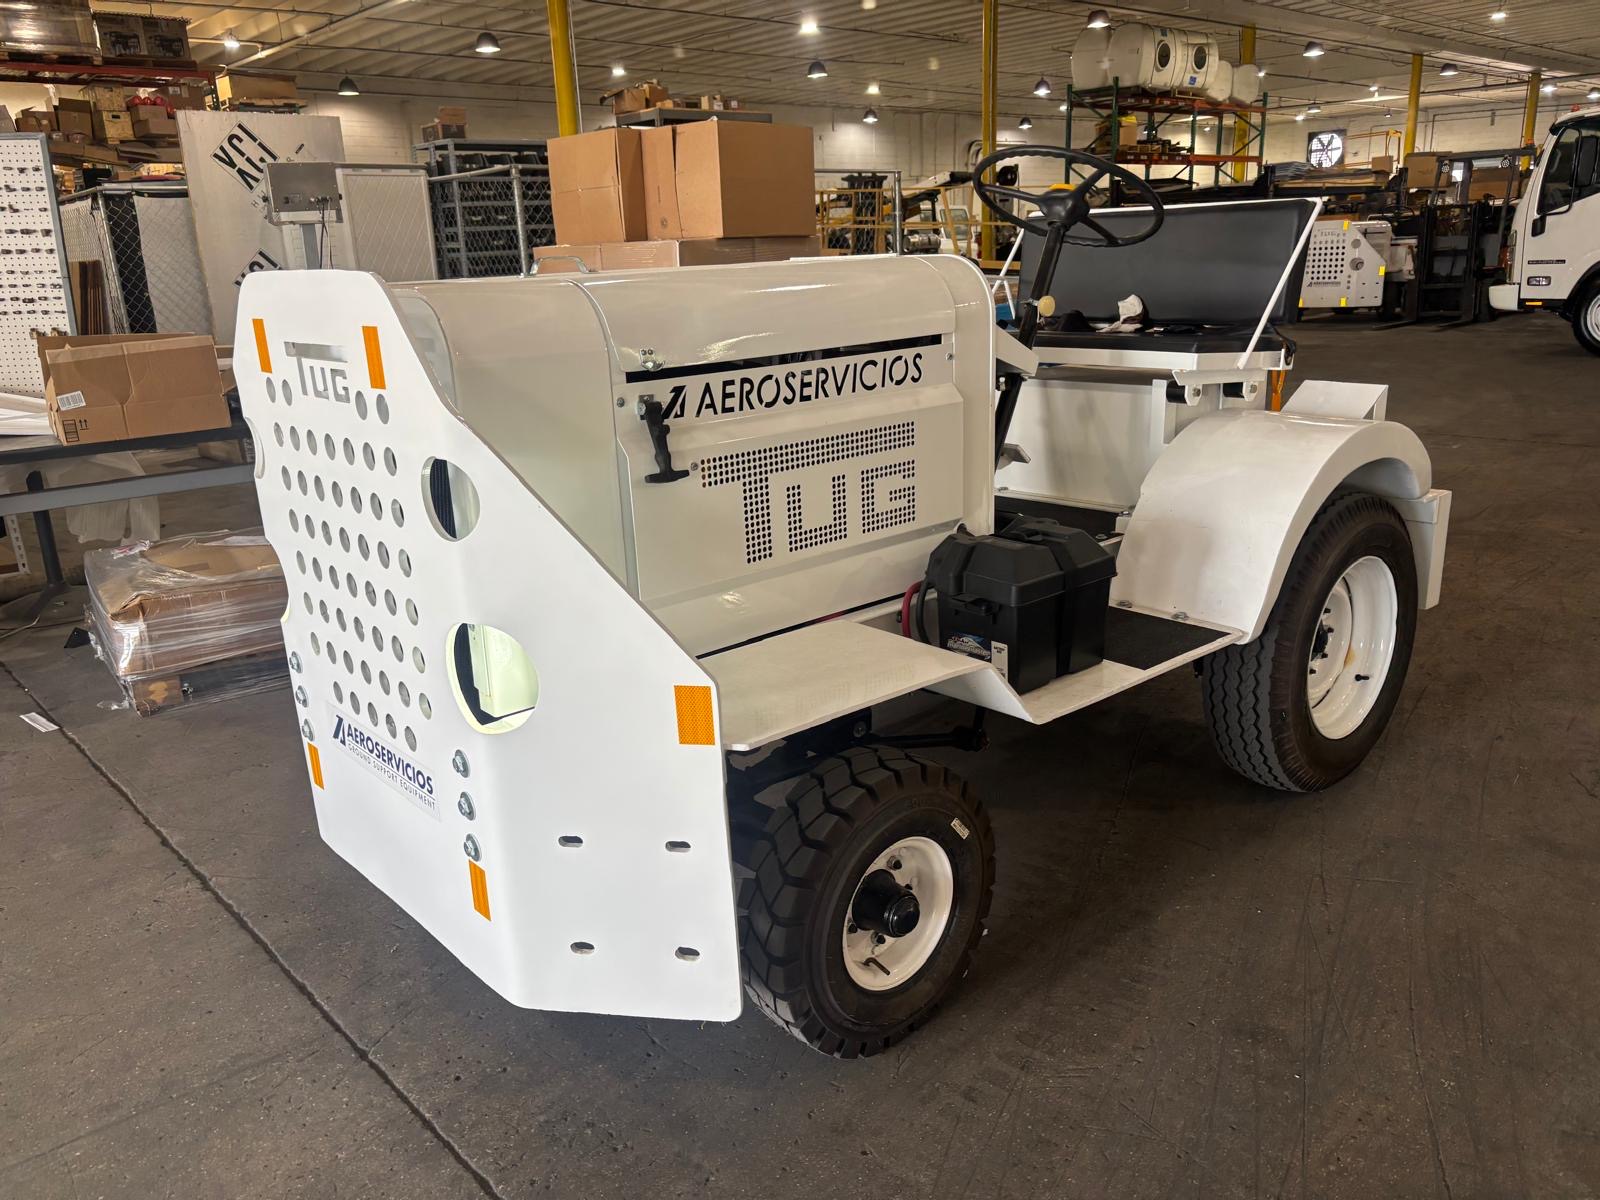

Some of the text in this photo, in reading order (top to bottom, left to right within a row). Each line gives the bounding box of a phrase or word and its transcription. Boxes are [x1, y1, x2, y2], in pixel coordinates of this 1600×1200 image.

[284, 341, 351, 403] TUG
[695, 353, 923, 418] AEROSERVICIOS
[700, 420, 916, 564] TUG
[347, 723, 433, 795] AEROSERVICIOS
[348, 743, 435, 810] GROUND SUPPORT EQUIPMENT
